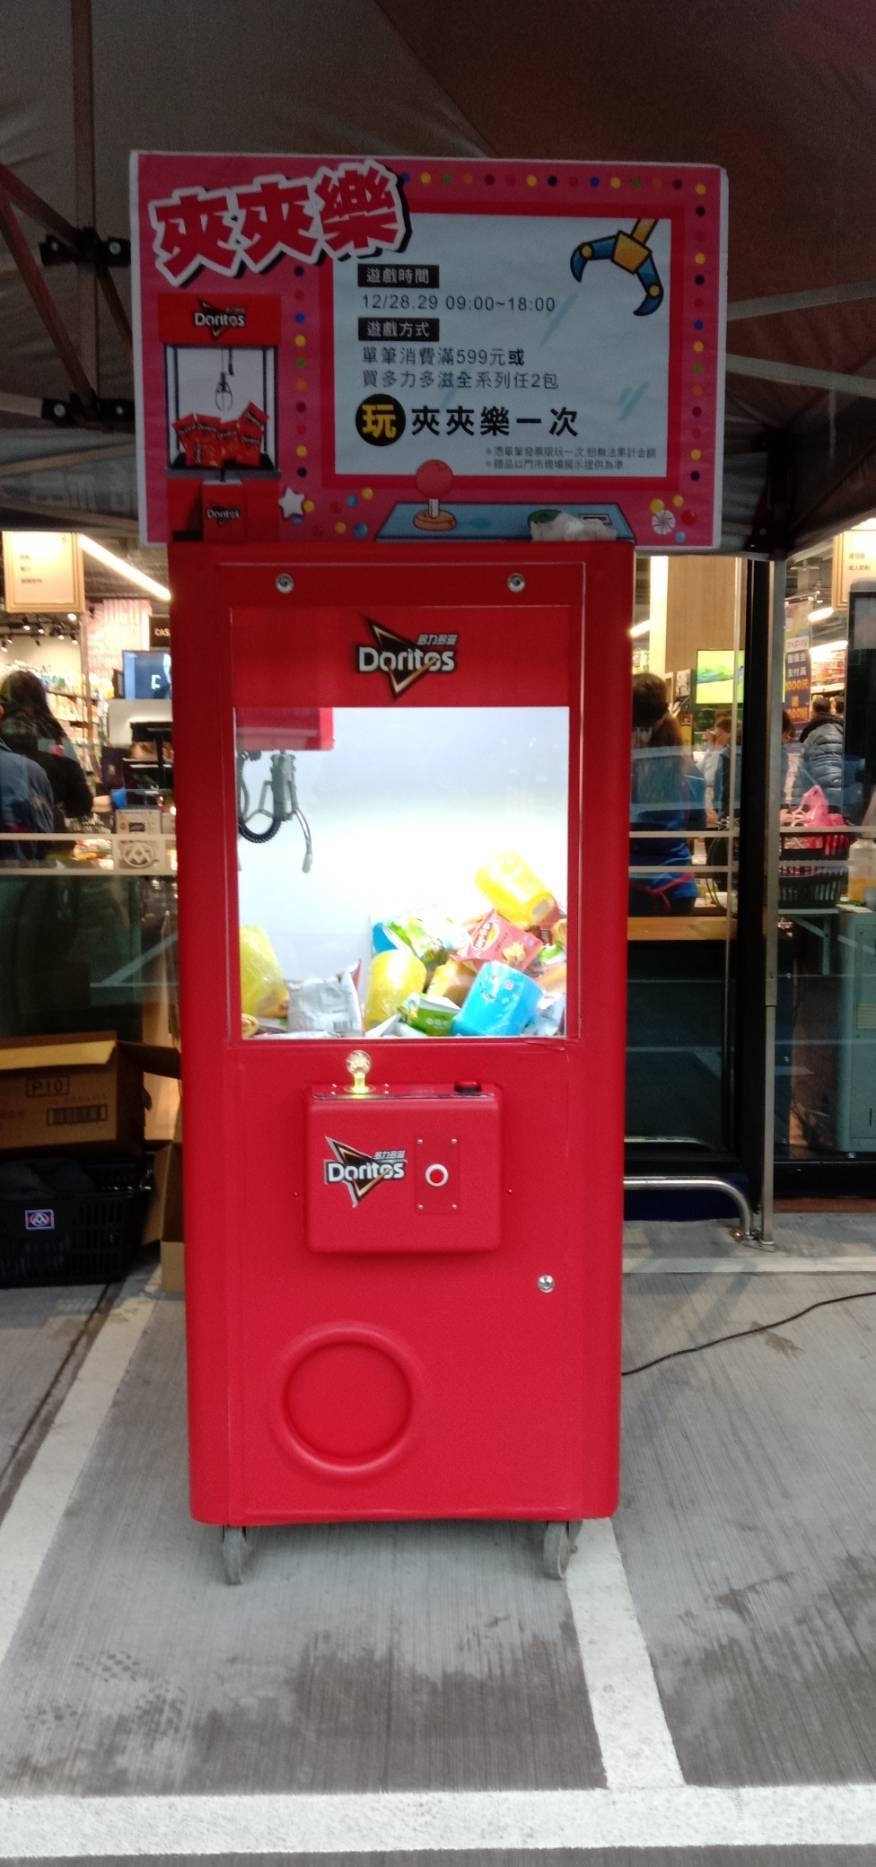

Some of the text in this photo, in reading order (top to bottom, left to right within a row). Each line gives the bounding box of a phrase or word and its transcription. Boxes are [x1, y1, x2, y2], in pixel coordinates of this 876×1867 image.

[150, 161, 403, 284] 夾夾樂
[366, 267, 430, 284] 遊戲時間
[362, 294, 556, 312] 12/28.29 09:00~18:00
[194, 312, 245, 327] Doritos
[366, 320, 430, 338] 遊戲方式
[362, 347, 525, 365] 單筆消費滿599元或
[362, 370, 559, 389] 買多力多滋全系列任2包
[361, 403, 578, 438] 玩 夾夾樂一次
[358, 646, 455, 672] Doritos
[32, 1079, 63, 1095] P10
[328, 1161, 405, 1182] Doritos
